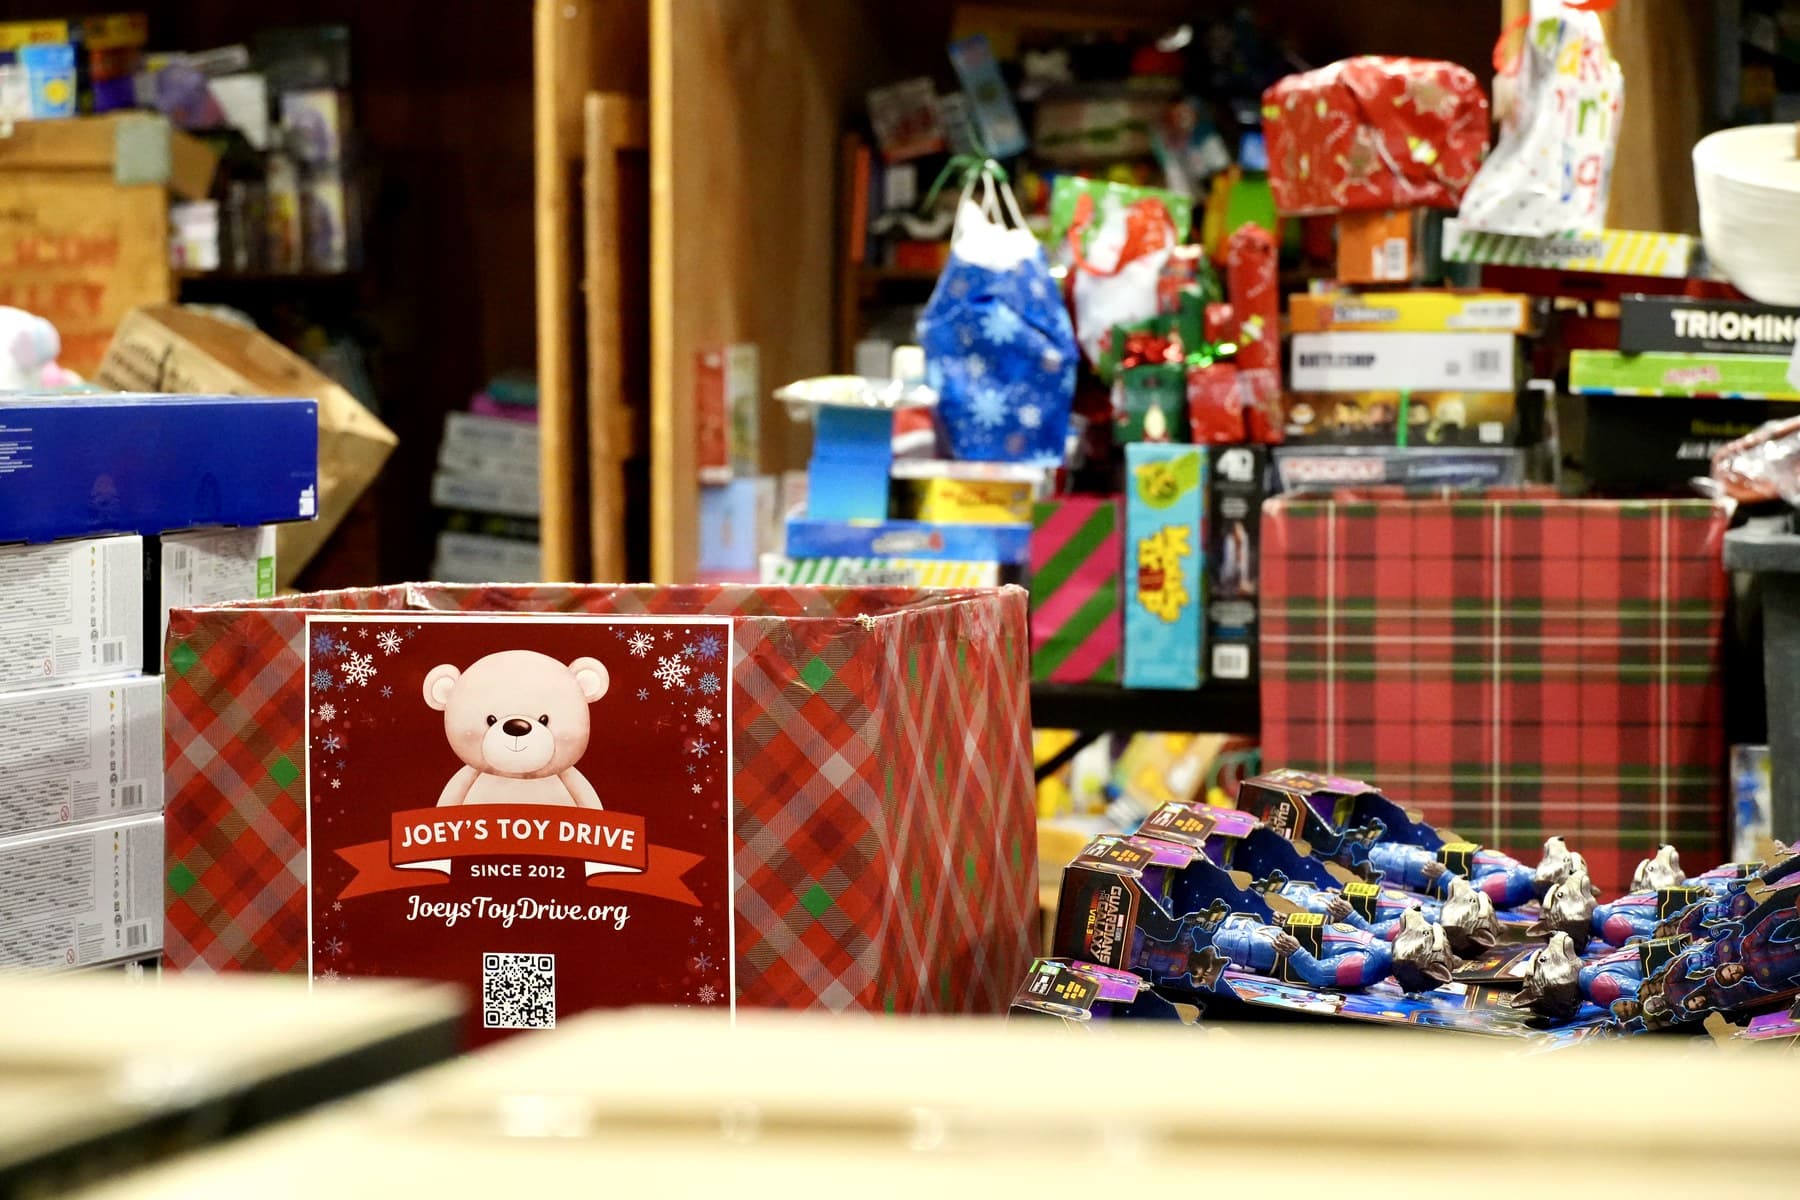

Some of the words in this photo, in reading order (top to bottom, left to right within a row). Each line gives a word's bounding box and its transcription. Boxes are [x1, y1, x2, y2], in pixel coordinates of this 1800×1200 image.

[401, 819, 489, 848] JOEY'S
[497, 818, 551, 840] TOY
[559, 821, 636, 851] DRIVE
[470, 864, 522, 878] SINCE
[527, 865, 566, 879] 2012
[406, 895, 631, 931] JoeysToyDrive.org
[1090, 902, 1109, 960] GALAXY
[1100, 886, 1122, 966] GUARDIANS
